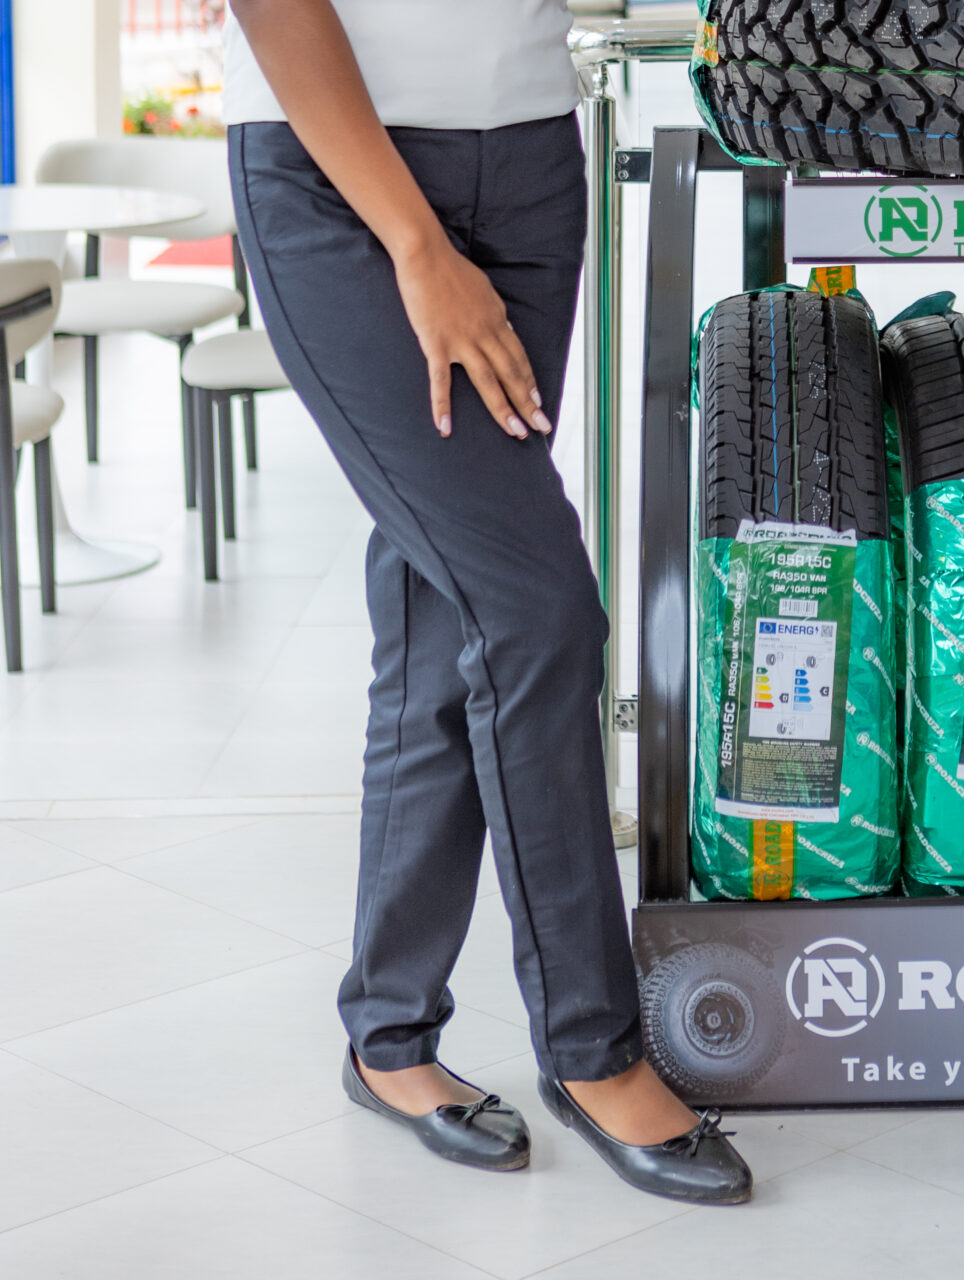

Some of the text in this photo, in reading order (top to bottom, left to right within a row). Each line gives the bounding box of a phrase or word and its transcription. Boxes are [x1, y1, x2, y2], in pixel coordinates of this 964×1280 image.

[770, 553, 832, 569] 195R15C
[778, 624, 814, 636] ENERG
[728, 661, 738, 697] RA350
[721, 701, 736, 769] 195R15C
[841, 1055, 926, 1082] Take
